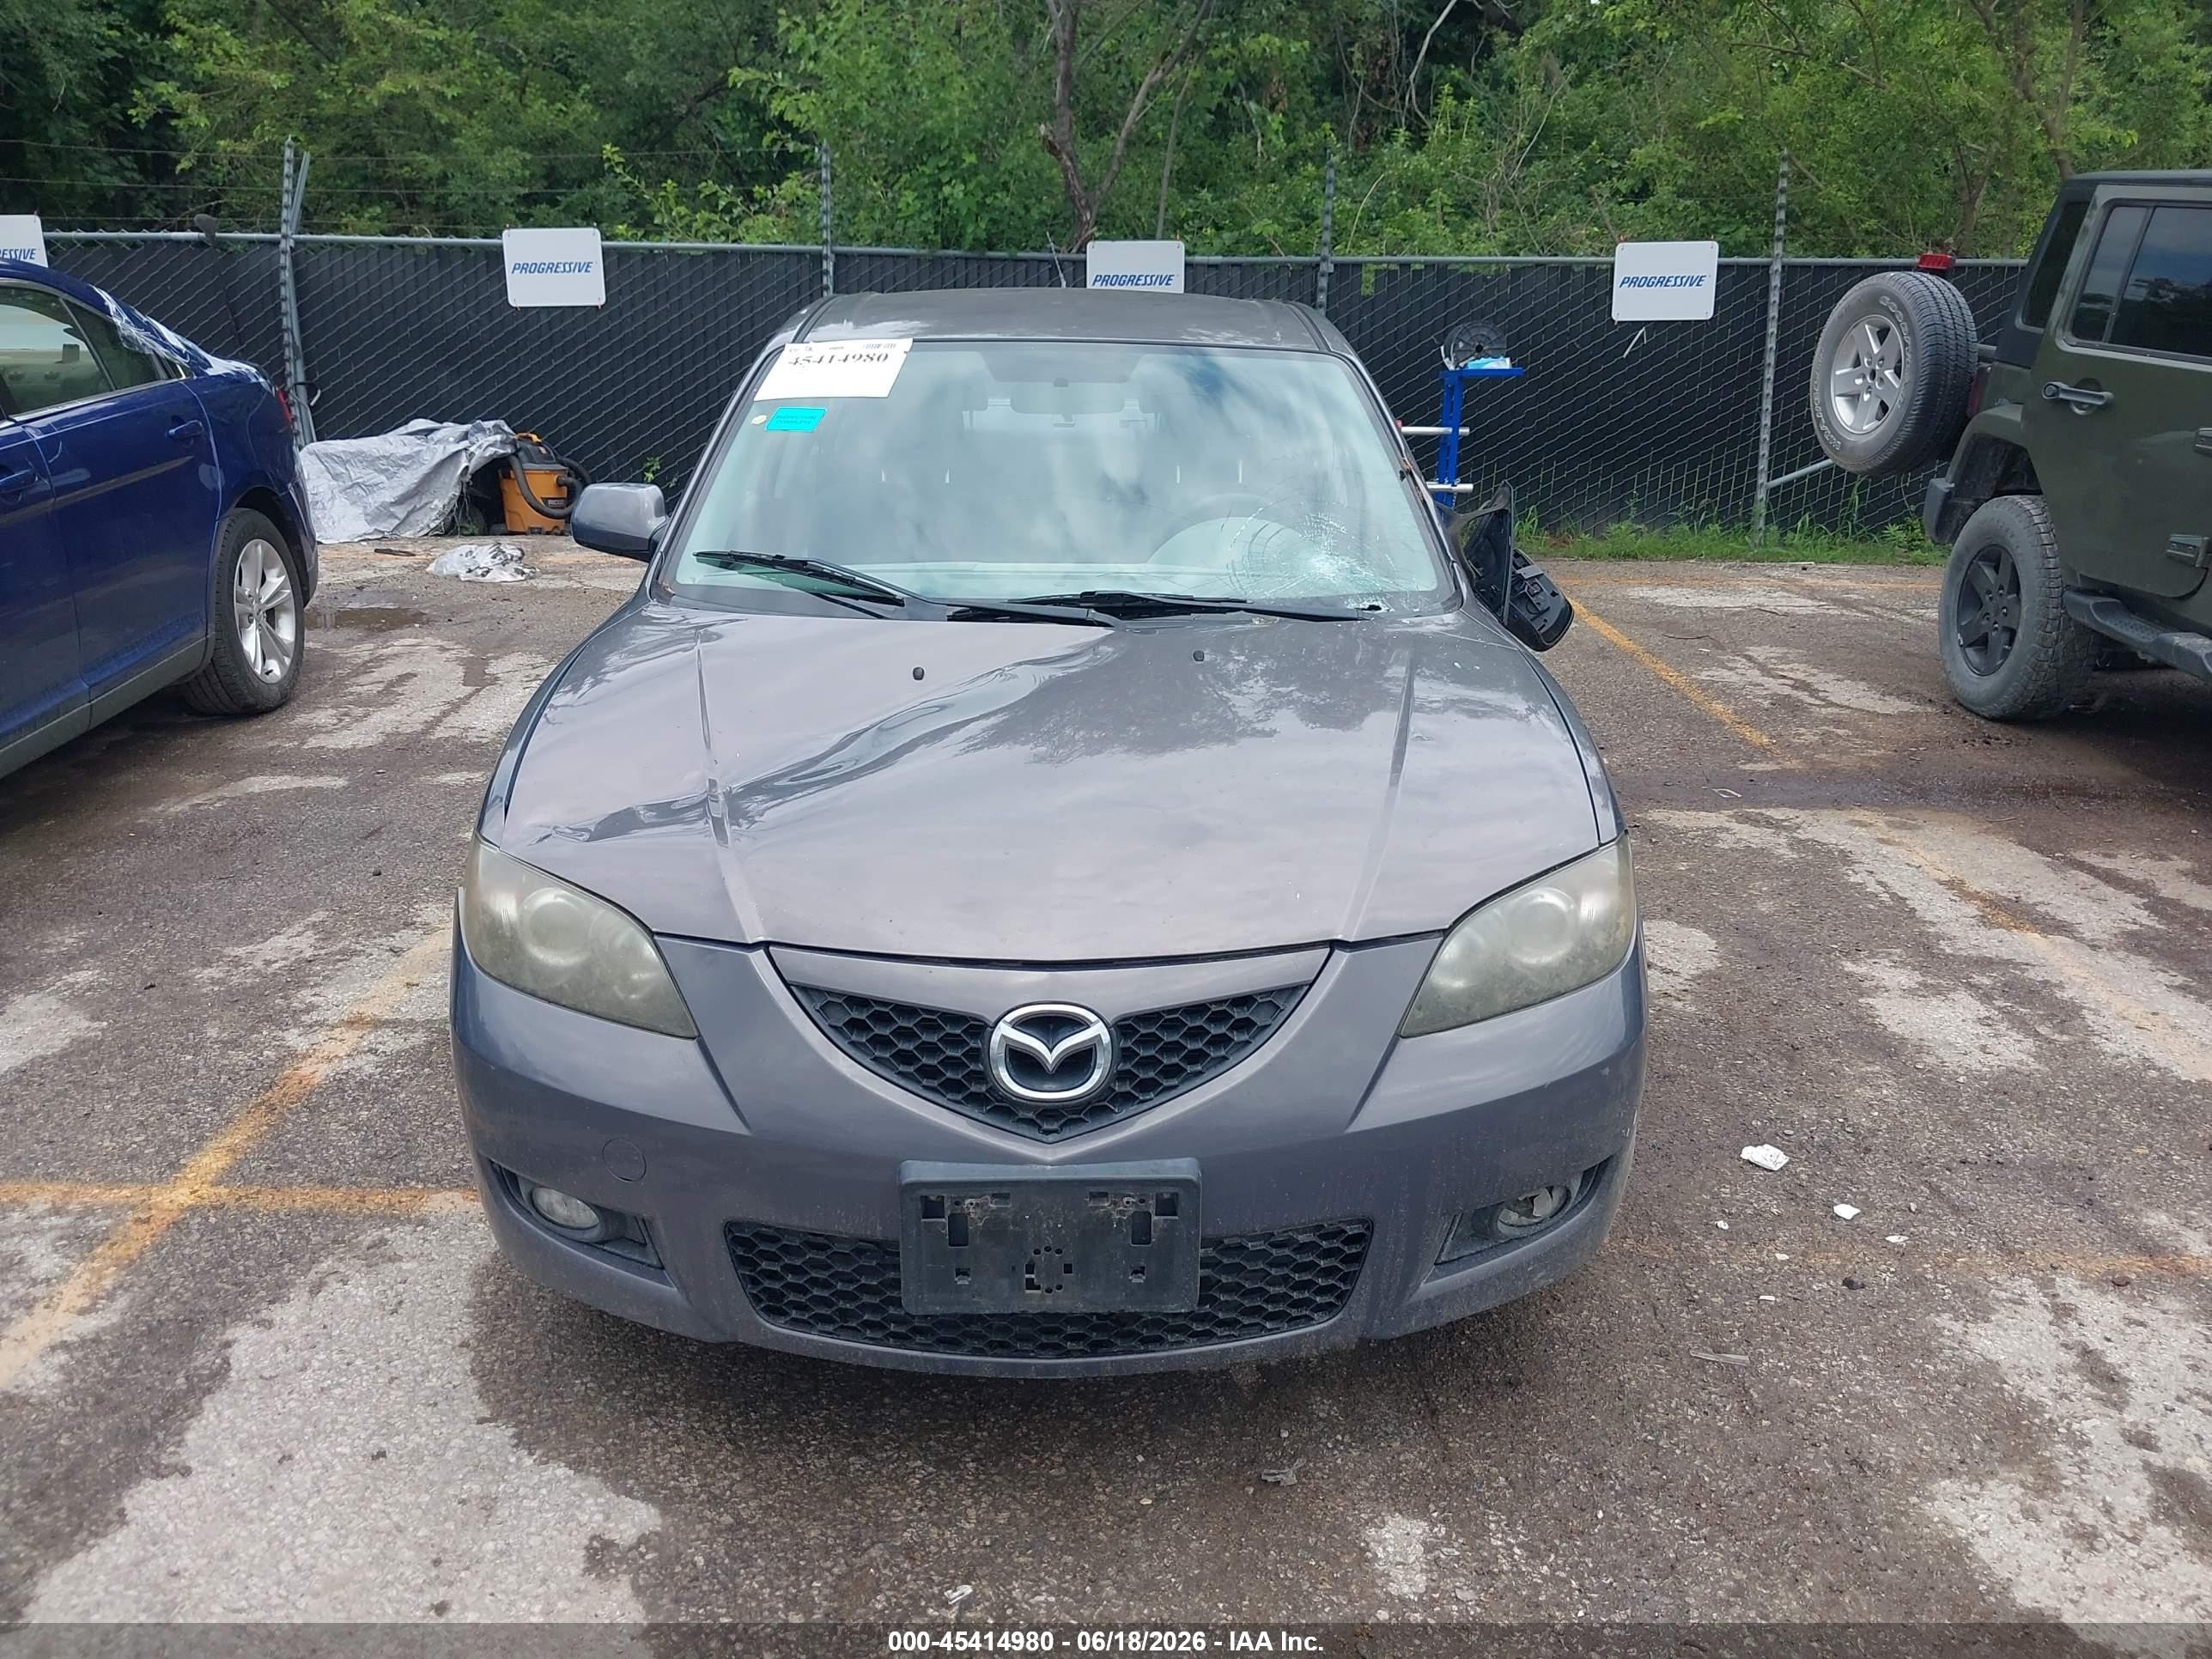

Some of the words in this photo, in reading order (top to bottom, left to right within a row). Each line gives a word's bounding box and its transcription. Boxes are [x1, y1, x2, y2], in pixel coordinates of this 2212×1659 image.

[0, 248, 37, 260] ESSIVE
[511, 261, 593, 274] PROGRESSIVE
[1092, 274, 1175, 287] PROGRESSIVE
[1619, 275, 1706, 289] PROGRESSIVE
[787, 352, 889, 366] 45414980
